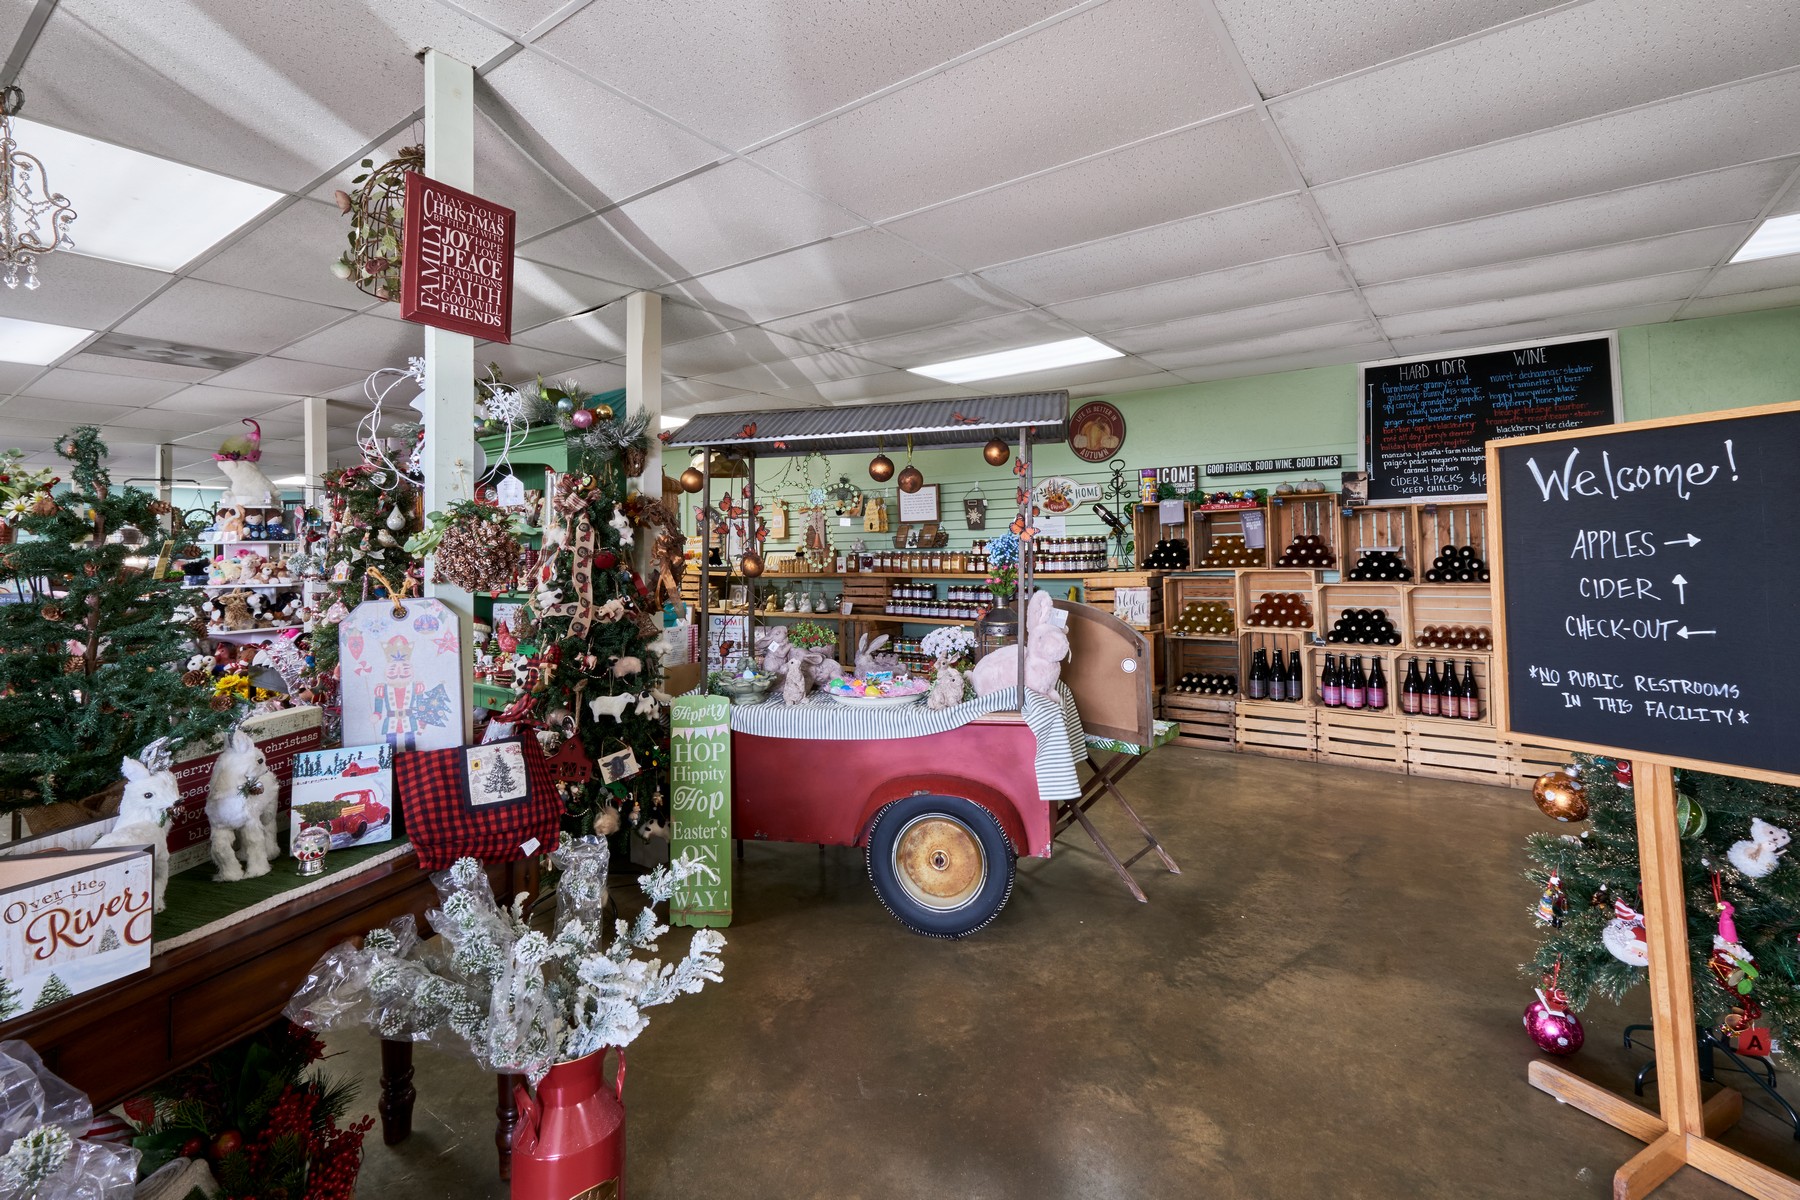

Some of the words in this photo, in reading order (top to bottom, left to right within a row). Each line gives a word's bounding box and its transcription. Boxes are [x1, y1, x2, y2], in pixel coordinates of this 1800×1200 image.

[424, 188, 504, 236] CHRISTMAS
[437, 192, 465, 209] MAY
[470, 204, 505, 224] YOUR
[433, 213, 445, 224] BE
[447, 218, 479, 235] FILLED
[481, 229, 504, 244] WITH
[442, 227, 475, 252] JOY
[475, 236, 503, 253] HOPE
[475, 246, 503, 263] LOVE
[421, 216, 441, 311] FAMILY
[441, 244, 503, 281] PEACE
[441, 264, 503, 290] TRADITIONS
[441, 274, 502, 306] FAITH
[441, 291, 502, 316] GOODWILL
[441, 301, 502, 327] FRIENDS
[1513, 347, 1547, 366] WINE
[1399, 363, 1430, 381] HARD
[1076, 411, 1086, 423] LIFE
[1085, 407, 1092, 415] IS
[1093, 405, 1112, 417] BETTER
[1496, 423, 1541, 433] blackberry
[1545, 421, 1557, 429] ice
[1558, 420, 1580, 428] cider
[1079, 448, 1110, 460] AUTUMN
[1207, 464, 1224, 475] GOOD
[1255, 460, 1273, 471] GOOD
[1296, 457, 1316, 468] GOOD
[1317, 455, 1339, 467] TIMES
[1423, 473, 1464, 485] 4-PACKS
[1526, 439, 1739, 502] Welcome!
[1075, 486, 1099, 500] HOME
[1570, 529, 1656, 560] APPLES
[1117, 591, 1141, 607] Hello
[1580, 577, 1662, 601] CIDER
[1565, 614, 1679, 642] CHECK-OUT
[1567, 669, 1624, 690] PUBLIC
[1634, 675, 1741, 699] RESTROOMS
[672, 703, 729, 726] Hippity
[1561, 692, 1582, 708] IN
[1593, 696, 1633, 714] THIS
[174, 760, 215, 780] merry
[265, 731, 319, 754] christmas
[674, 742, 727, 764] HOP
[673, 765, 728, 785] Hippity
[180, 783, 211, 801] peac
[673, 786, 725, 820] Hop
[182, 806, 206, 824] joy
[672, 820, 728, 841] Easter's
[4, 889, 63, 924] Over
[70, 880, 99, 894] the
[25, 887, 149, 960] River
[1747, 1035, 1763, 1051] A
